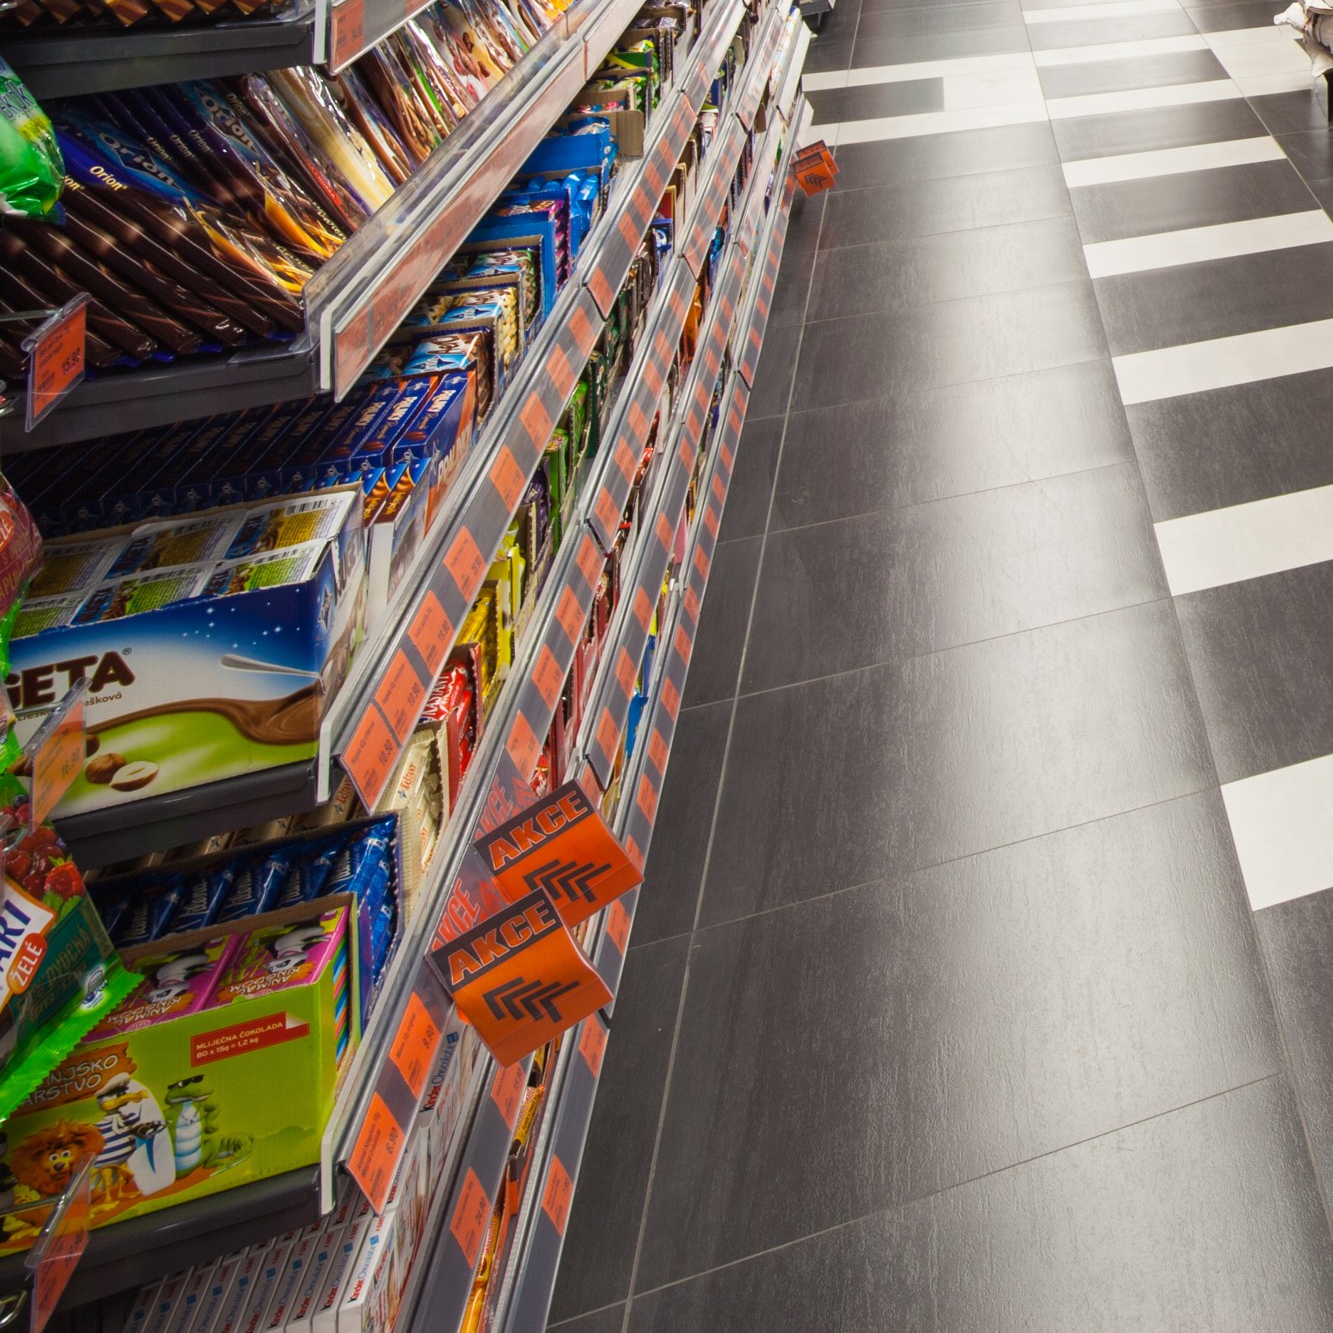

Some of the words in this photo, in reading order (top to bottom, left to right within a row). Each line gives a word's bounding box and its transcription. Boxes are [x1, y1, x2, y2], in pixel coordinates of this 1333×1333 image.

[89, 165, 127, 192] Orion
[488, 791, 590, 871] AKCE
[449, 903, 557, 986] AKCE
[15, 942, 44, 988] ŽELÉ
[196, 1032, 238, 1051] MLIJEČNA
[239, 1020, 283, 1040] ČOKOLADA
[420, 1084, 442, 1113] Kinder
[386, 1126, 399, 1155] 6.90
